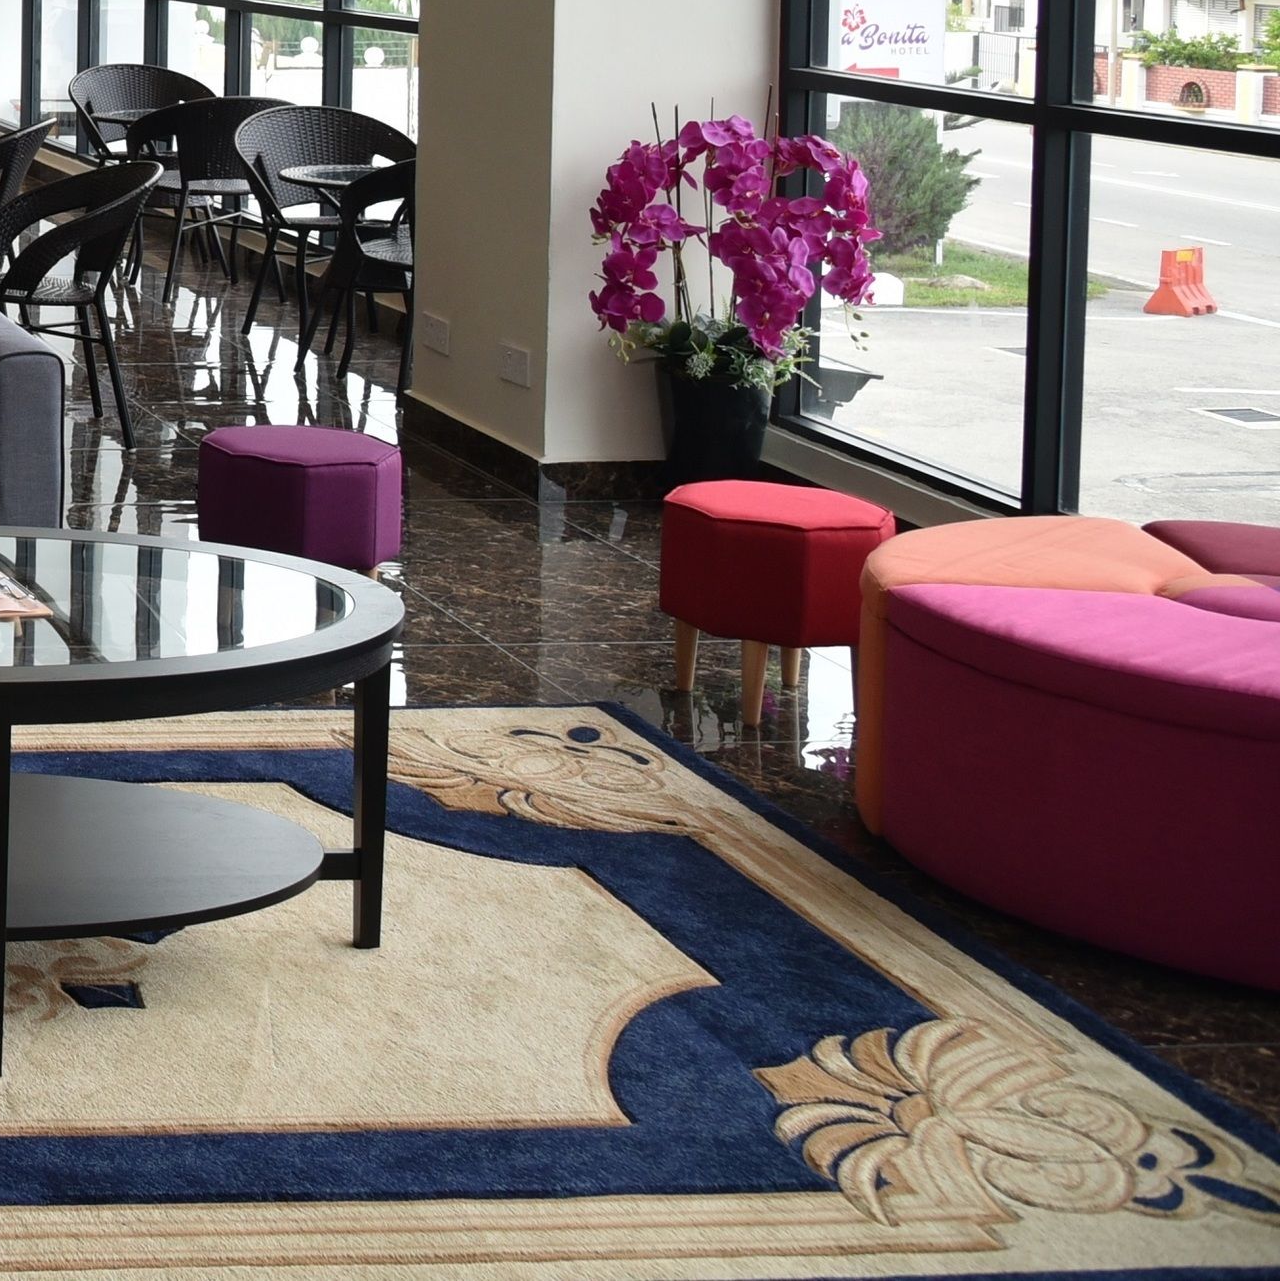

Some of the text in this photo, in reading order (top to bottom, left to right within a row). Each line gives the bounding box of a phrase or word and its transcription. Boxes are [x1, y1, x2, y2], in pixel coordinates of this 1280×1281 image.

[841, 23, 930, 50] a Bonita
[890, 46, 930, 55] HOTEL
